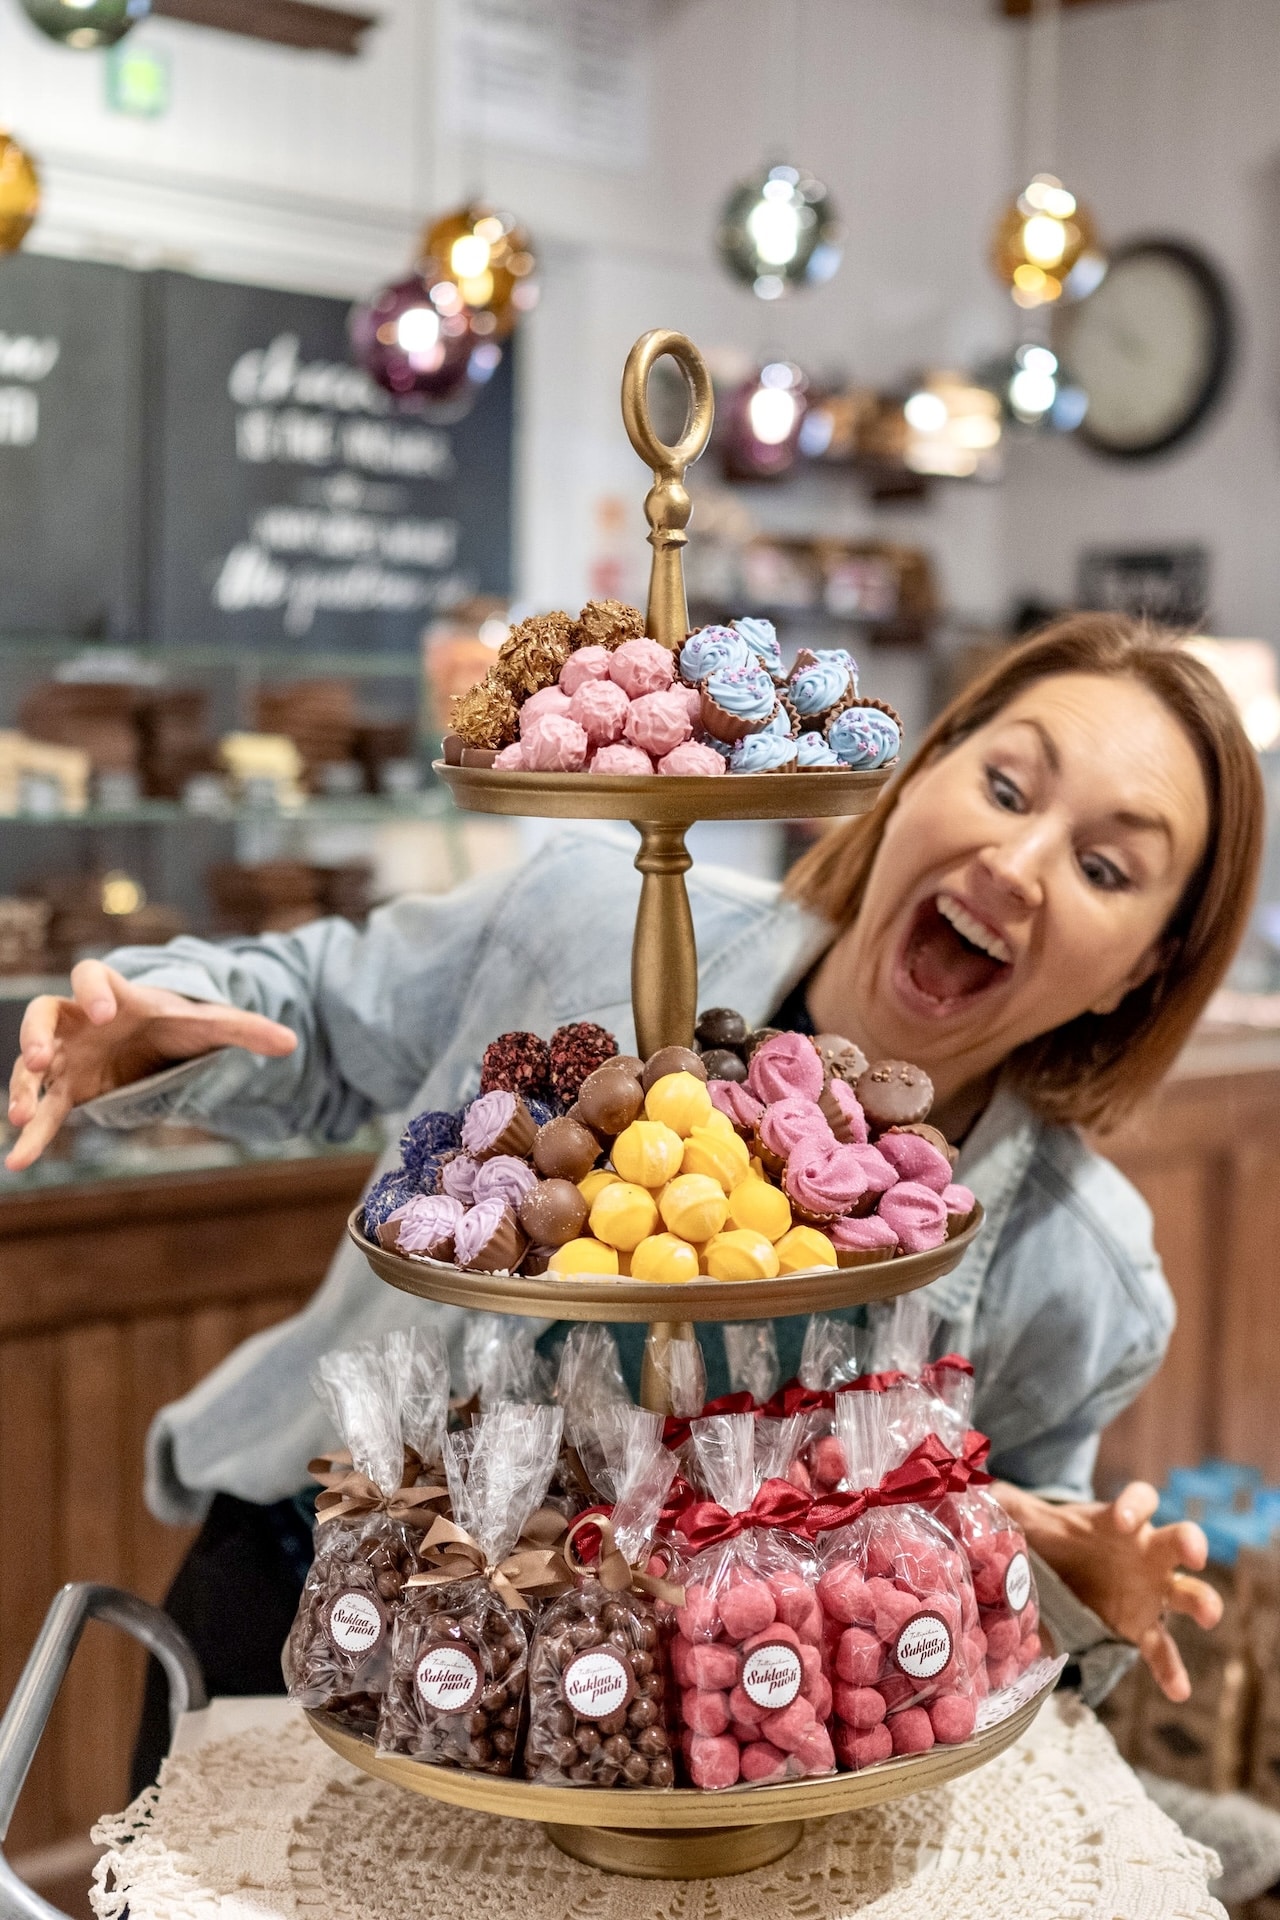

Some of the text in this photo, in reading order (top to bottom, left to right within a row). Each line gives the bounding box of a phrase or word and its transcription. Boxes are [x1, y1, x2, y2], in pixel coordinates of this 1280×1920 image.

[345, 1625, 377, 1636] puoti
[919, 1638, 947, 1665] puoti
[438, 1678, 474, 1694] puoti
[591, 1675, 623, 1703] puoti
[768, 1668, 798, 1694] puoti
